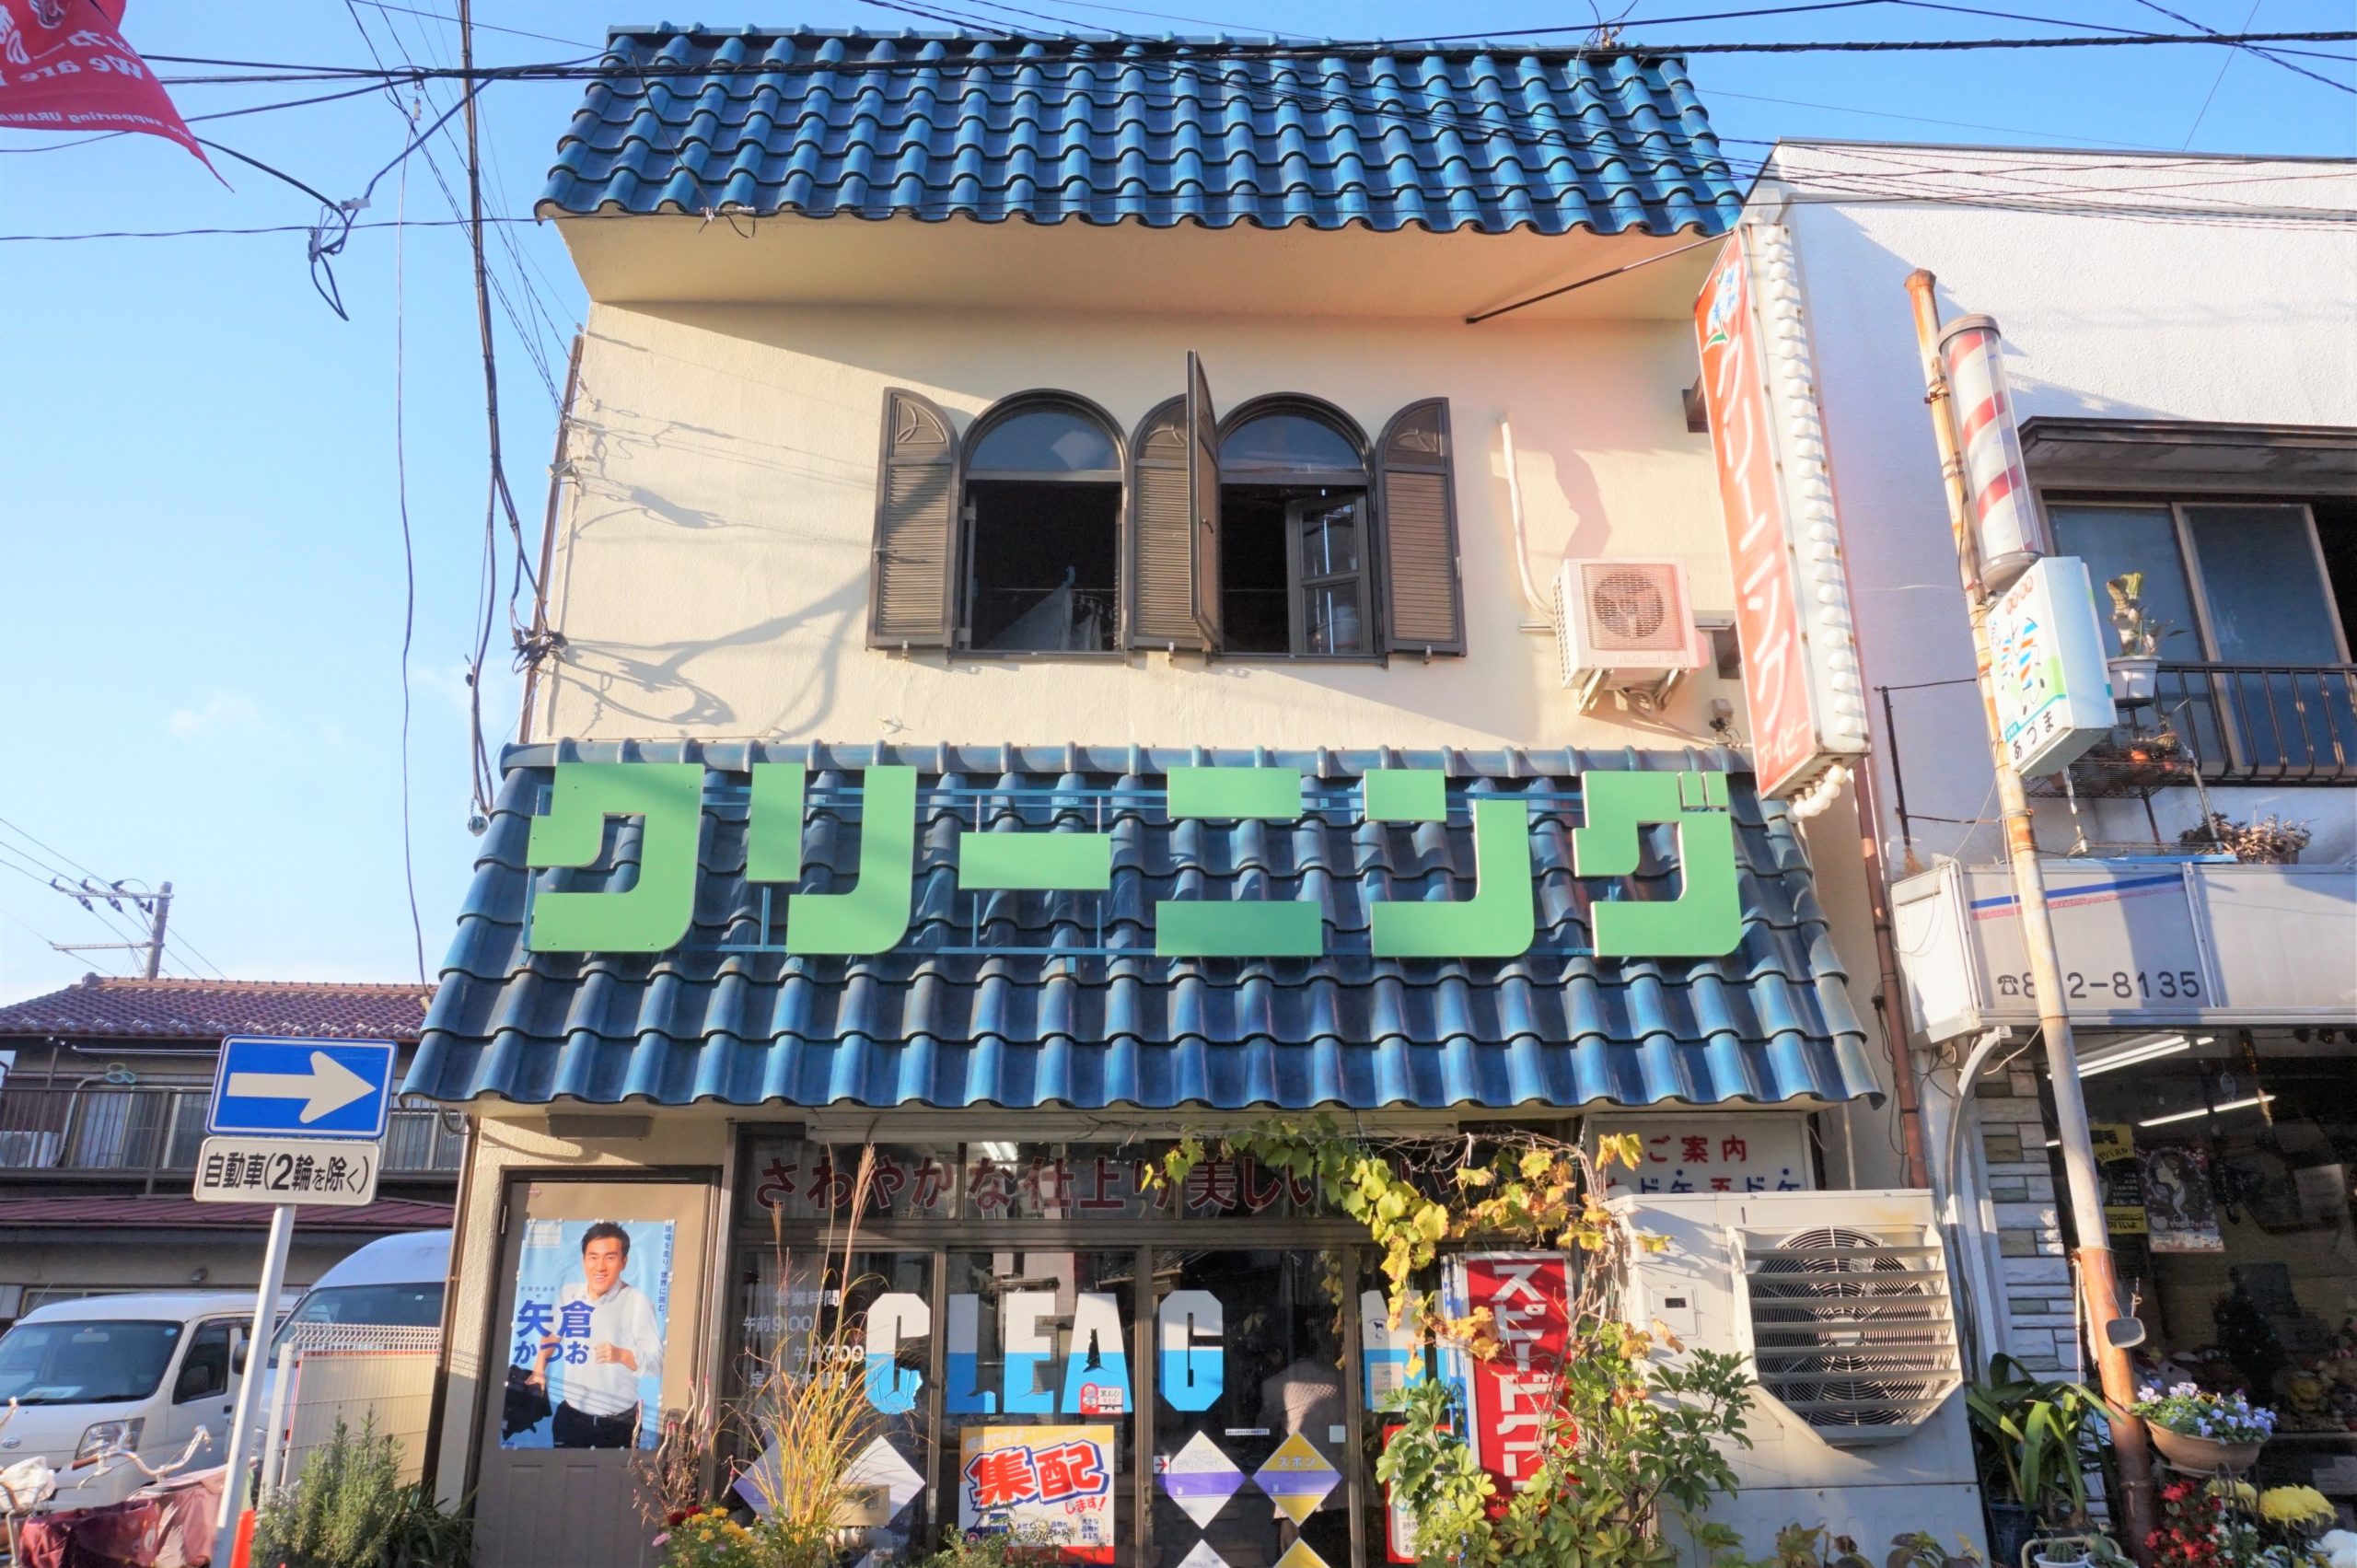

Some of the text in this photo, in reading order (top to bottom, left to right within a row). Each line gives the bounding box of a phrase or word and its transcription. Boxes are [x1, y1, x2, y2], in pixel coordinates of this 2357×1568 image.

[527, 763, 1740, 958] クリーニング
[2022, 970, 2200, 999] 82-8135
[1648, 1134, 1747, 1164] ご案内
[517, 1299, 596, 1339] 矢倉
[742, 1314, 814, 1332] 午前900
[513, 1341, 590, 1365] かつお
[967, 1442, 1107, 1510] 集配
[1064, 1496, 1107, 1515] します!
